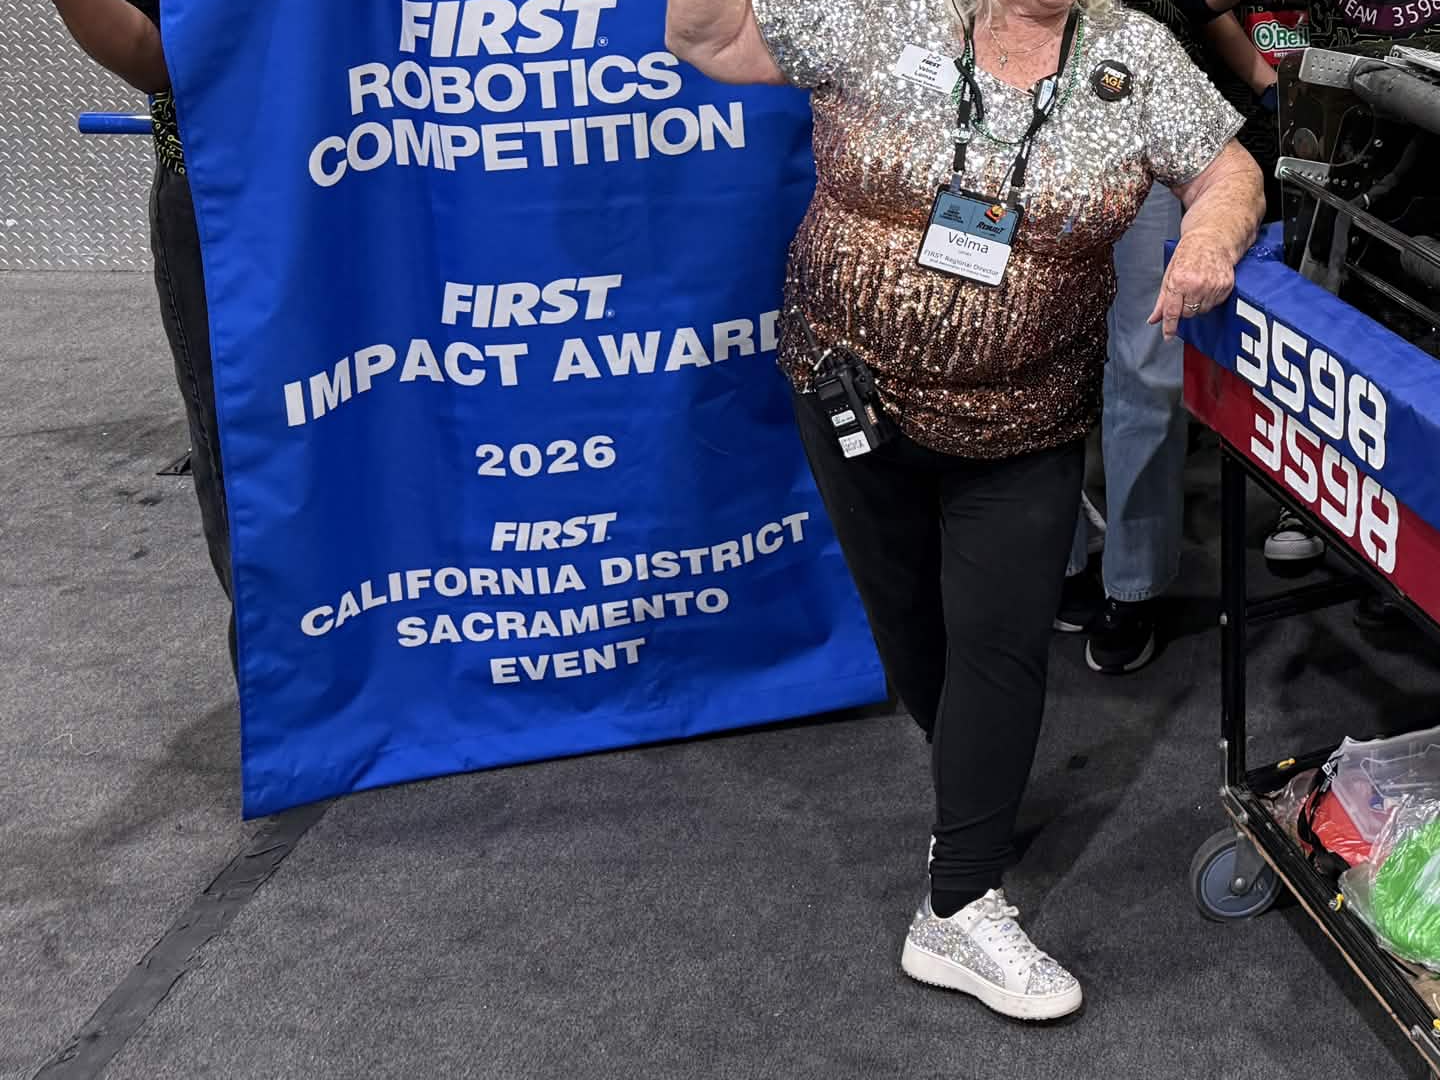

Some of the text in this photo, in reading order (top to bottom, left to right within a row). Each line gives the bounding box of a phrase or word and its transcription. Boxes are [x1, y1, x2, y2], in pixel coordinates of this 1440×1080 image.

[348, 51, 682, 115] ROBOTICS
[308, 102, 745, 188] COMPETITION
[948, 231, 989, 254] Velma
[441, 274, 623, 328] FIRST
[284, 338, 528, 427] IMPACT
[1235, 299, 1387, 470] 3598
[475, 435, 616, 477] 2026
[1250, 391, 1400, 576] 3598
[490, 512, 617, 552] FIRST
[300, 511, 810, 637] CALIFORNIA DISTRICT
[396, 587, 729, 648] SACRAMENTO
[490, 637, 646, 685] EVENT
